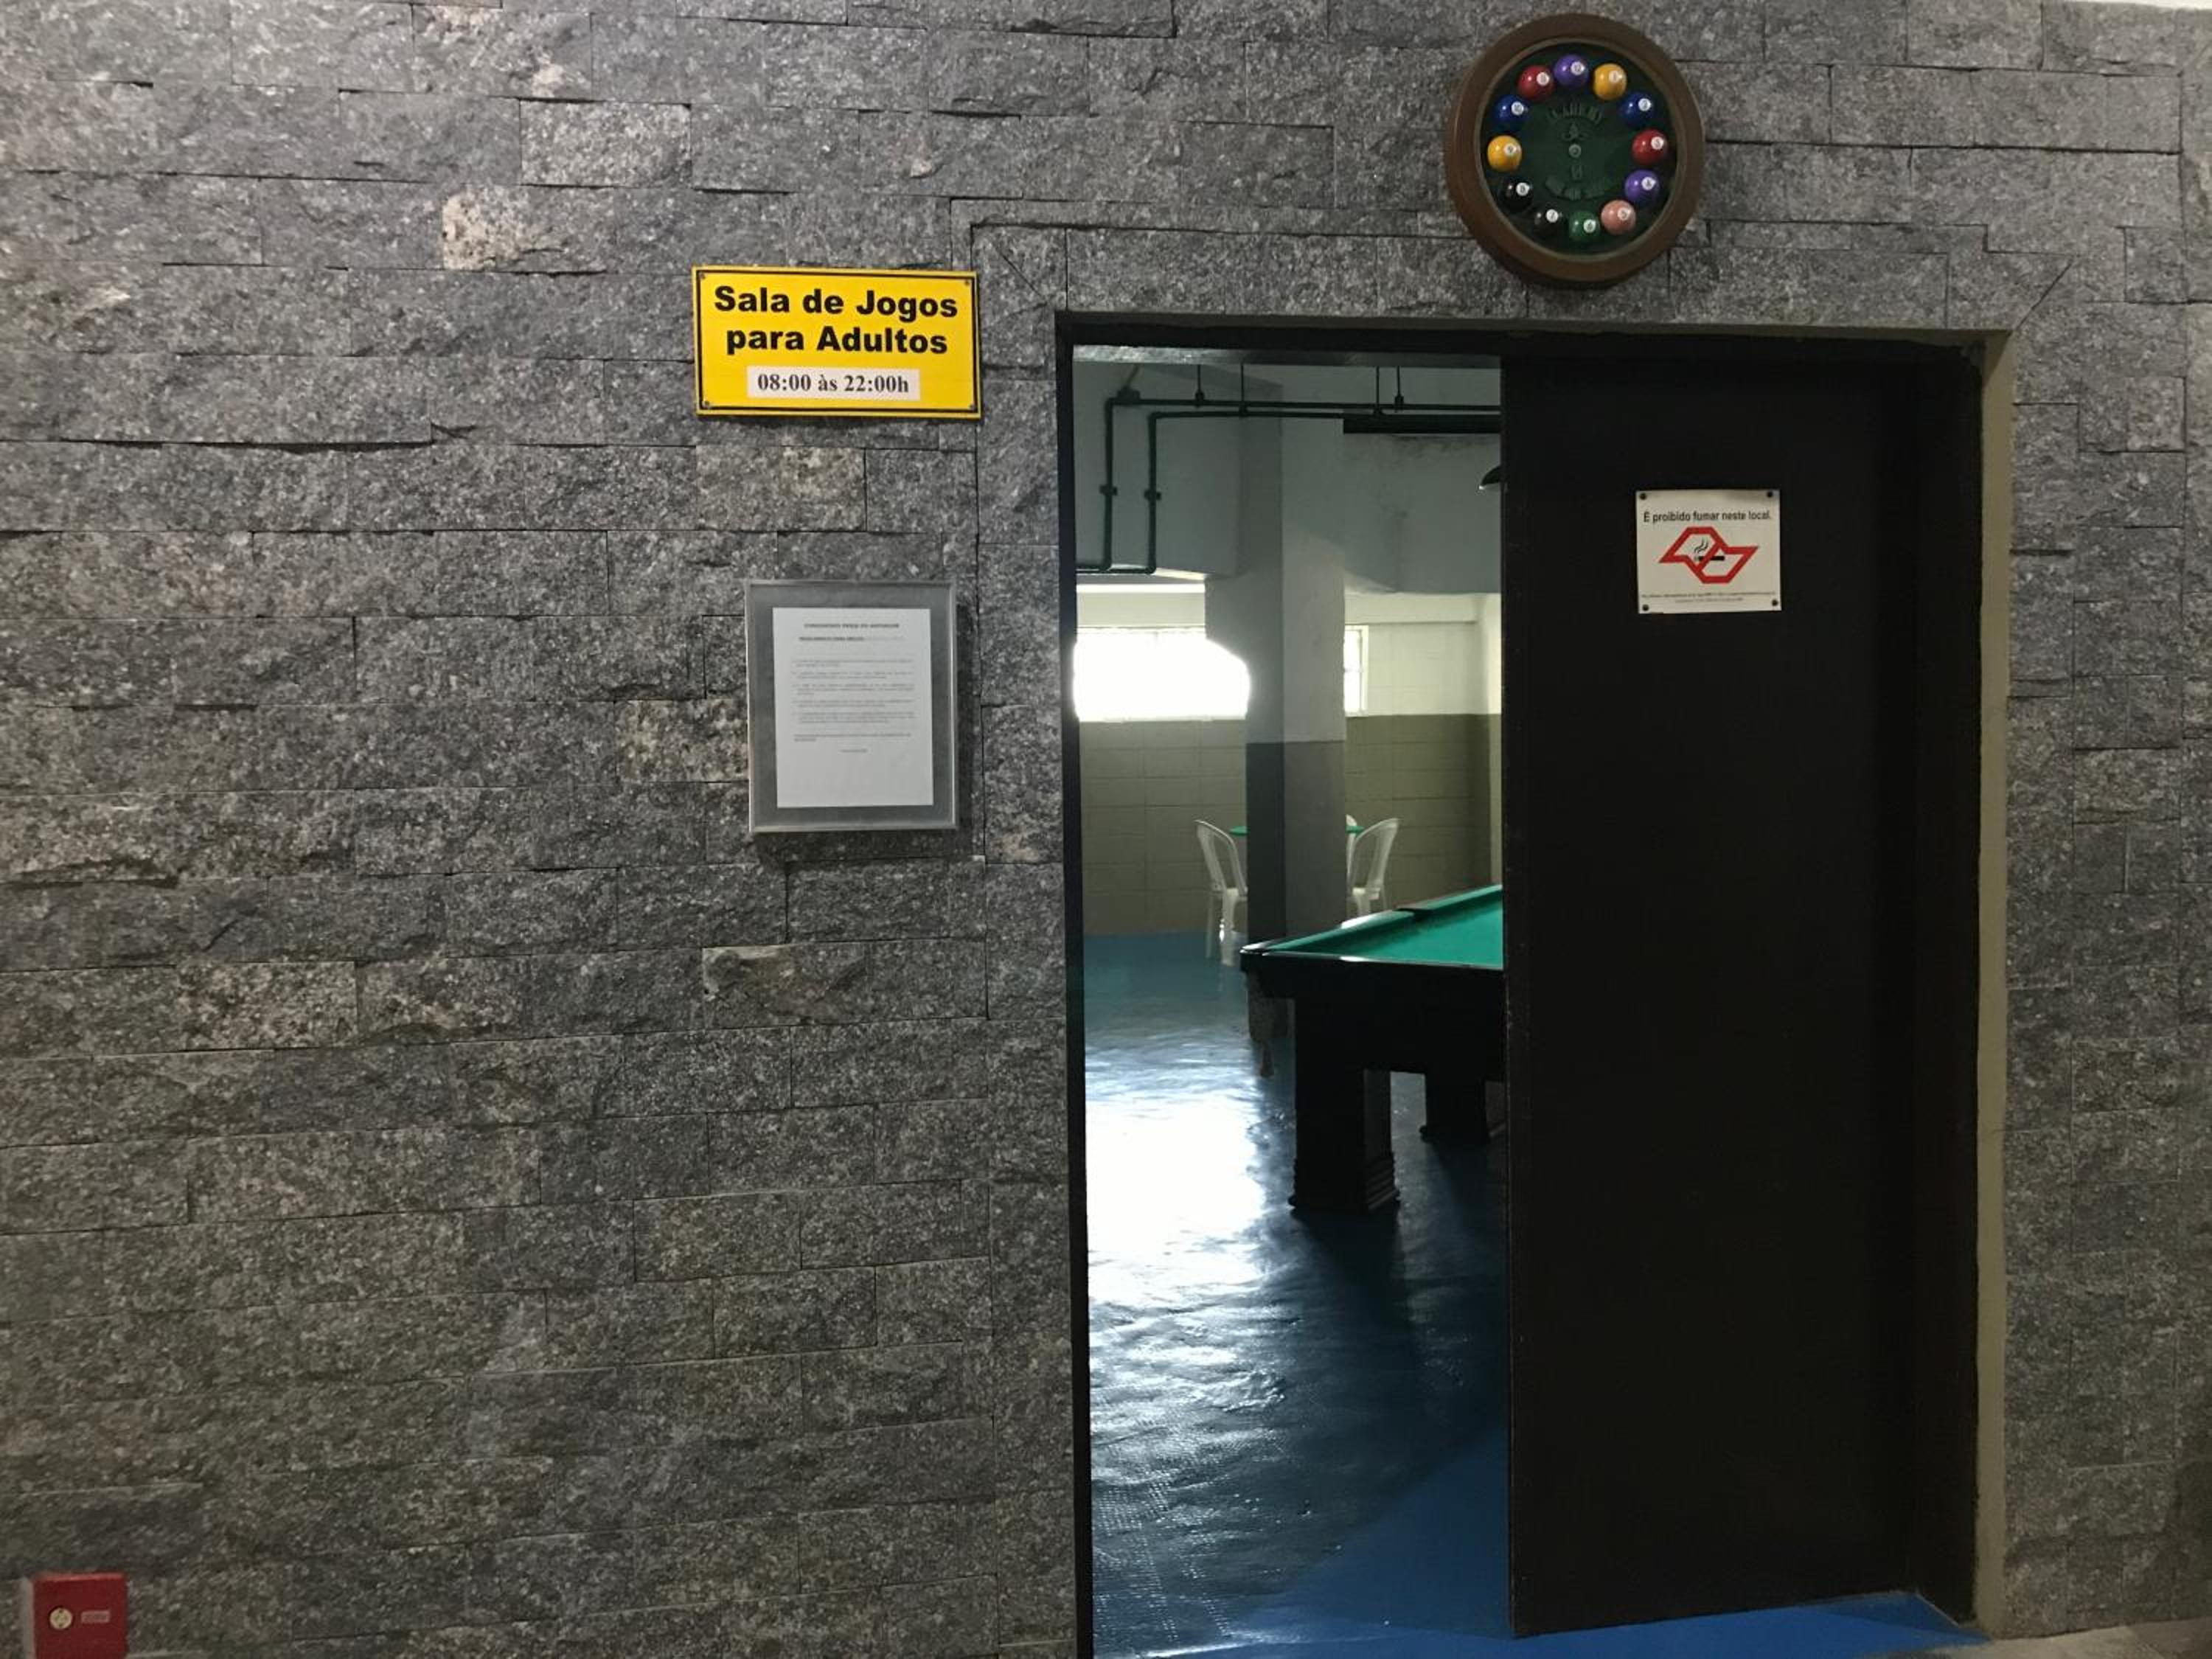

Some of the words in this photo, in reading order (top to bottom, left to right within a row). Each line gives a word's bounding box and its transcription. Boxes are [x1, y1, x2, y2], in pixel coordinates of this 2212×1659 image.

[714, 285, 790, 313] Sala
[802, 288, 844, 313] de
[857, 290, 958, 322] Jogos
[726, 330, 804, 355] para
[816, 326, 947, 354] Adultos
[757, 374, 812, 392] 08:00
[818, 373, 838, 392] às
[844, 375, 909, 393] 22:00h
[1652, 511, 1691, 524] proibido
[1693, 511, 1719, 522] fumar
[1722, 511, 1746, 521] neste
[1748, 510, 1771, 521] local.
